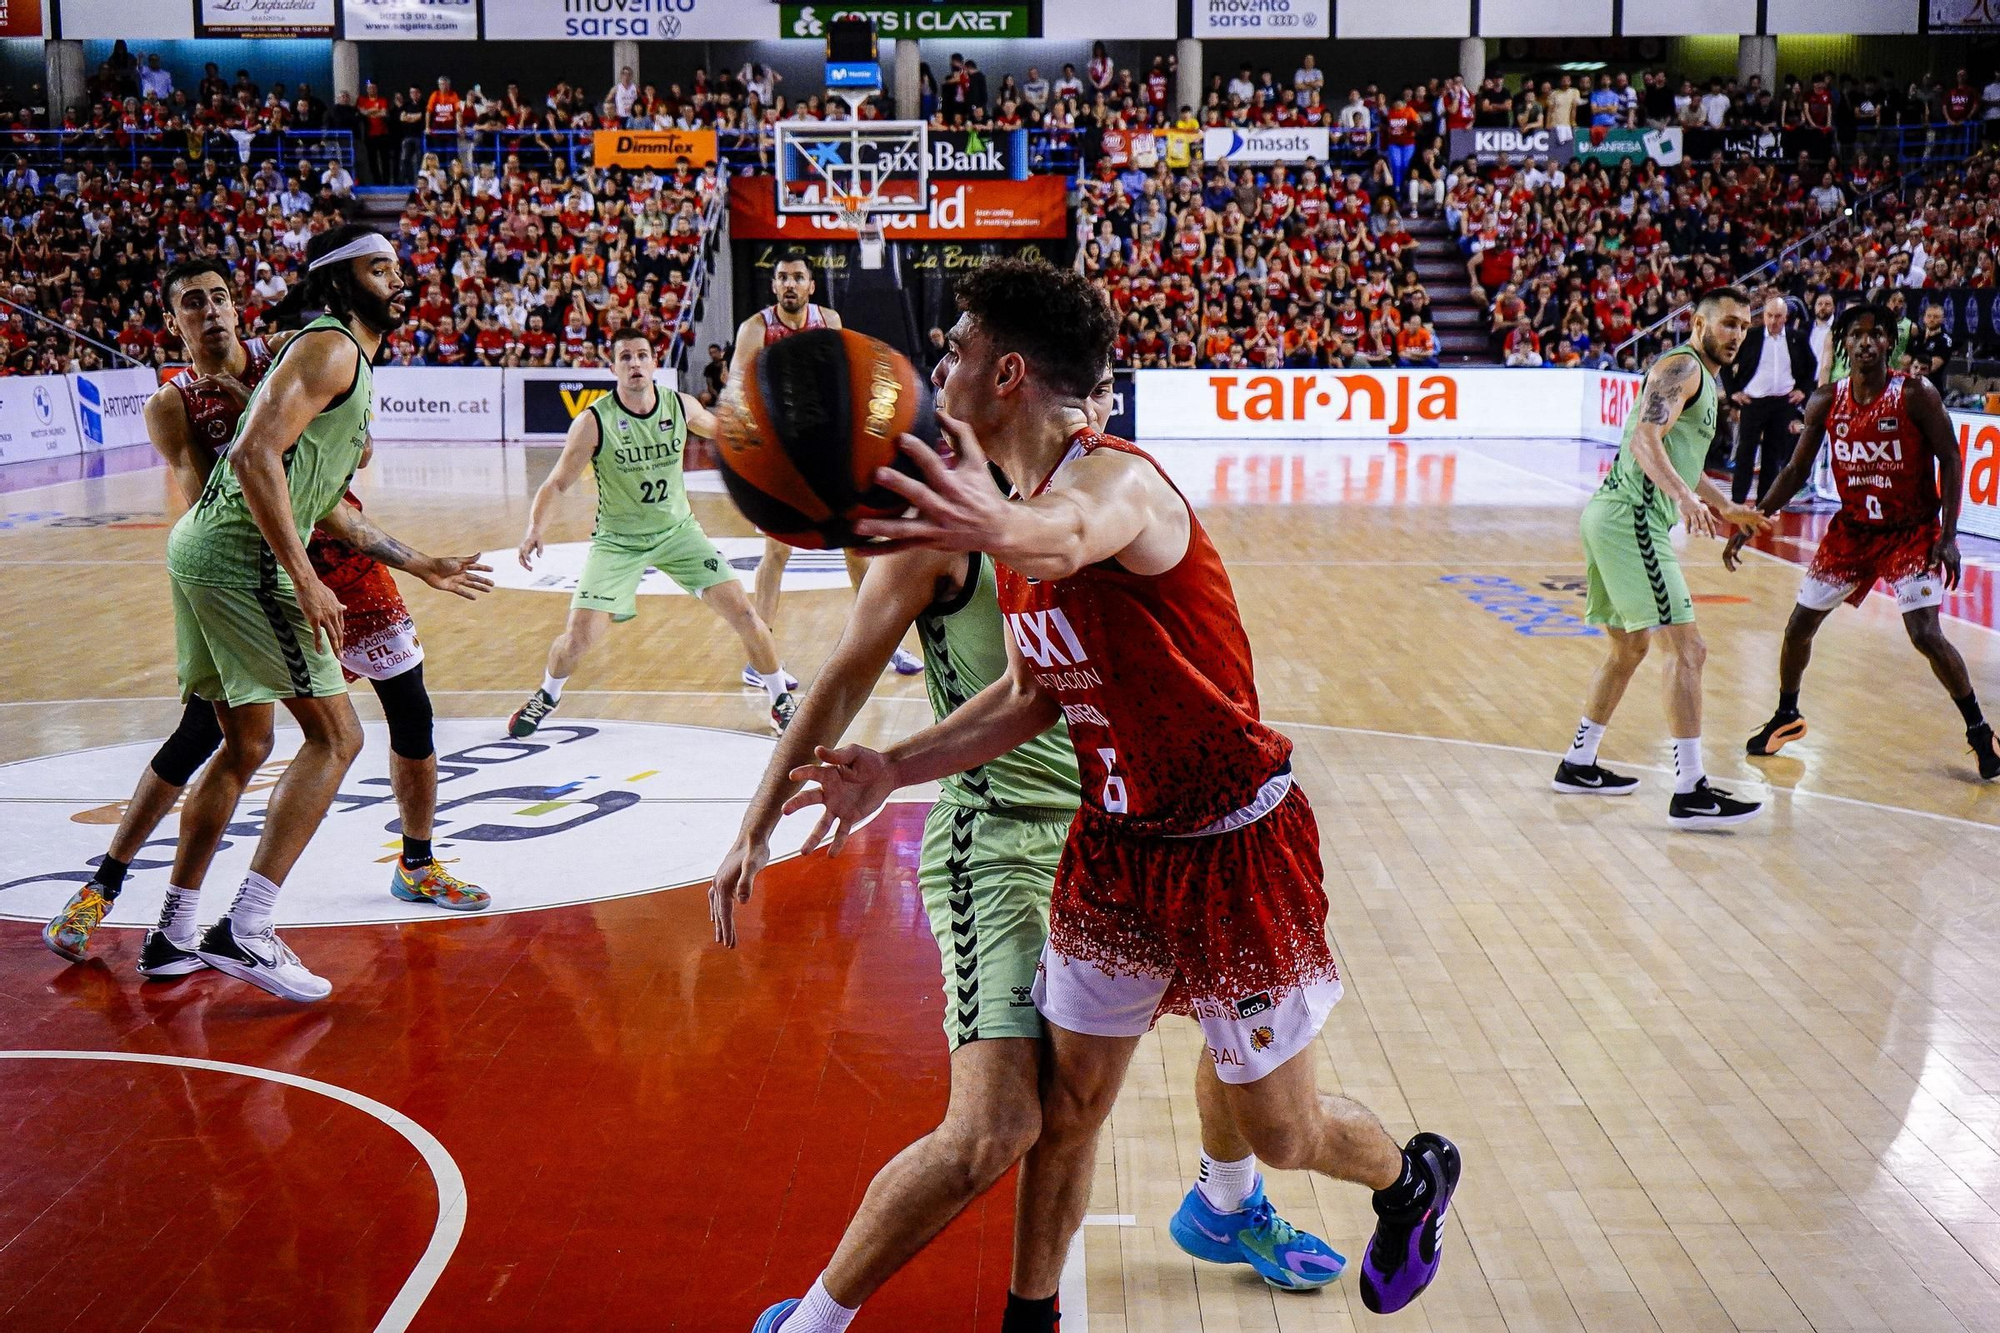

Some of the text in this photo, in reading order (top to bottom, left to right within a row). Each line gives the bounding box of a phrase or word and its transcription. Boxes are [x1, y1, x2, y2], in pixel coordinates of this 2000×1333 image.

[566, 18, 649, 36] sarsa
[916, 11, 1012, 31] CLARET
[1210, 15, 1261, 27] sarsa
[1247, 135, 1310, 151] masats
[1474, 130, 1550, 152] KIBUC
[559, 382, 584, 391] GRUP
[380, 397, 490, 414] Kouten.cat
[614, 438, 682, 465] surne
[1834, 438, 1903, 463] BAXI
[640, 478, 669, 504] 22
[1847, 474, 1893, 489] MANRESA
[1865, 494, 1884, 519] 0
[1008, 606, 1089, 668] AXI
[366, 644, 394, 662] ETL
[372, 649, 415, 673] GLOBAL
[1242, 1001, 1266, 1017] acb
[1208, 1047, 1246, 1066] BAL
